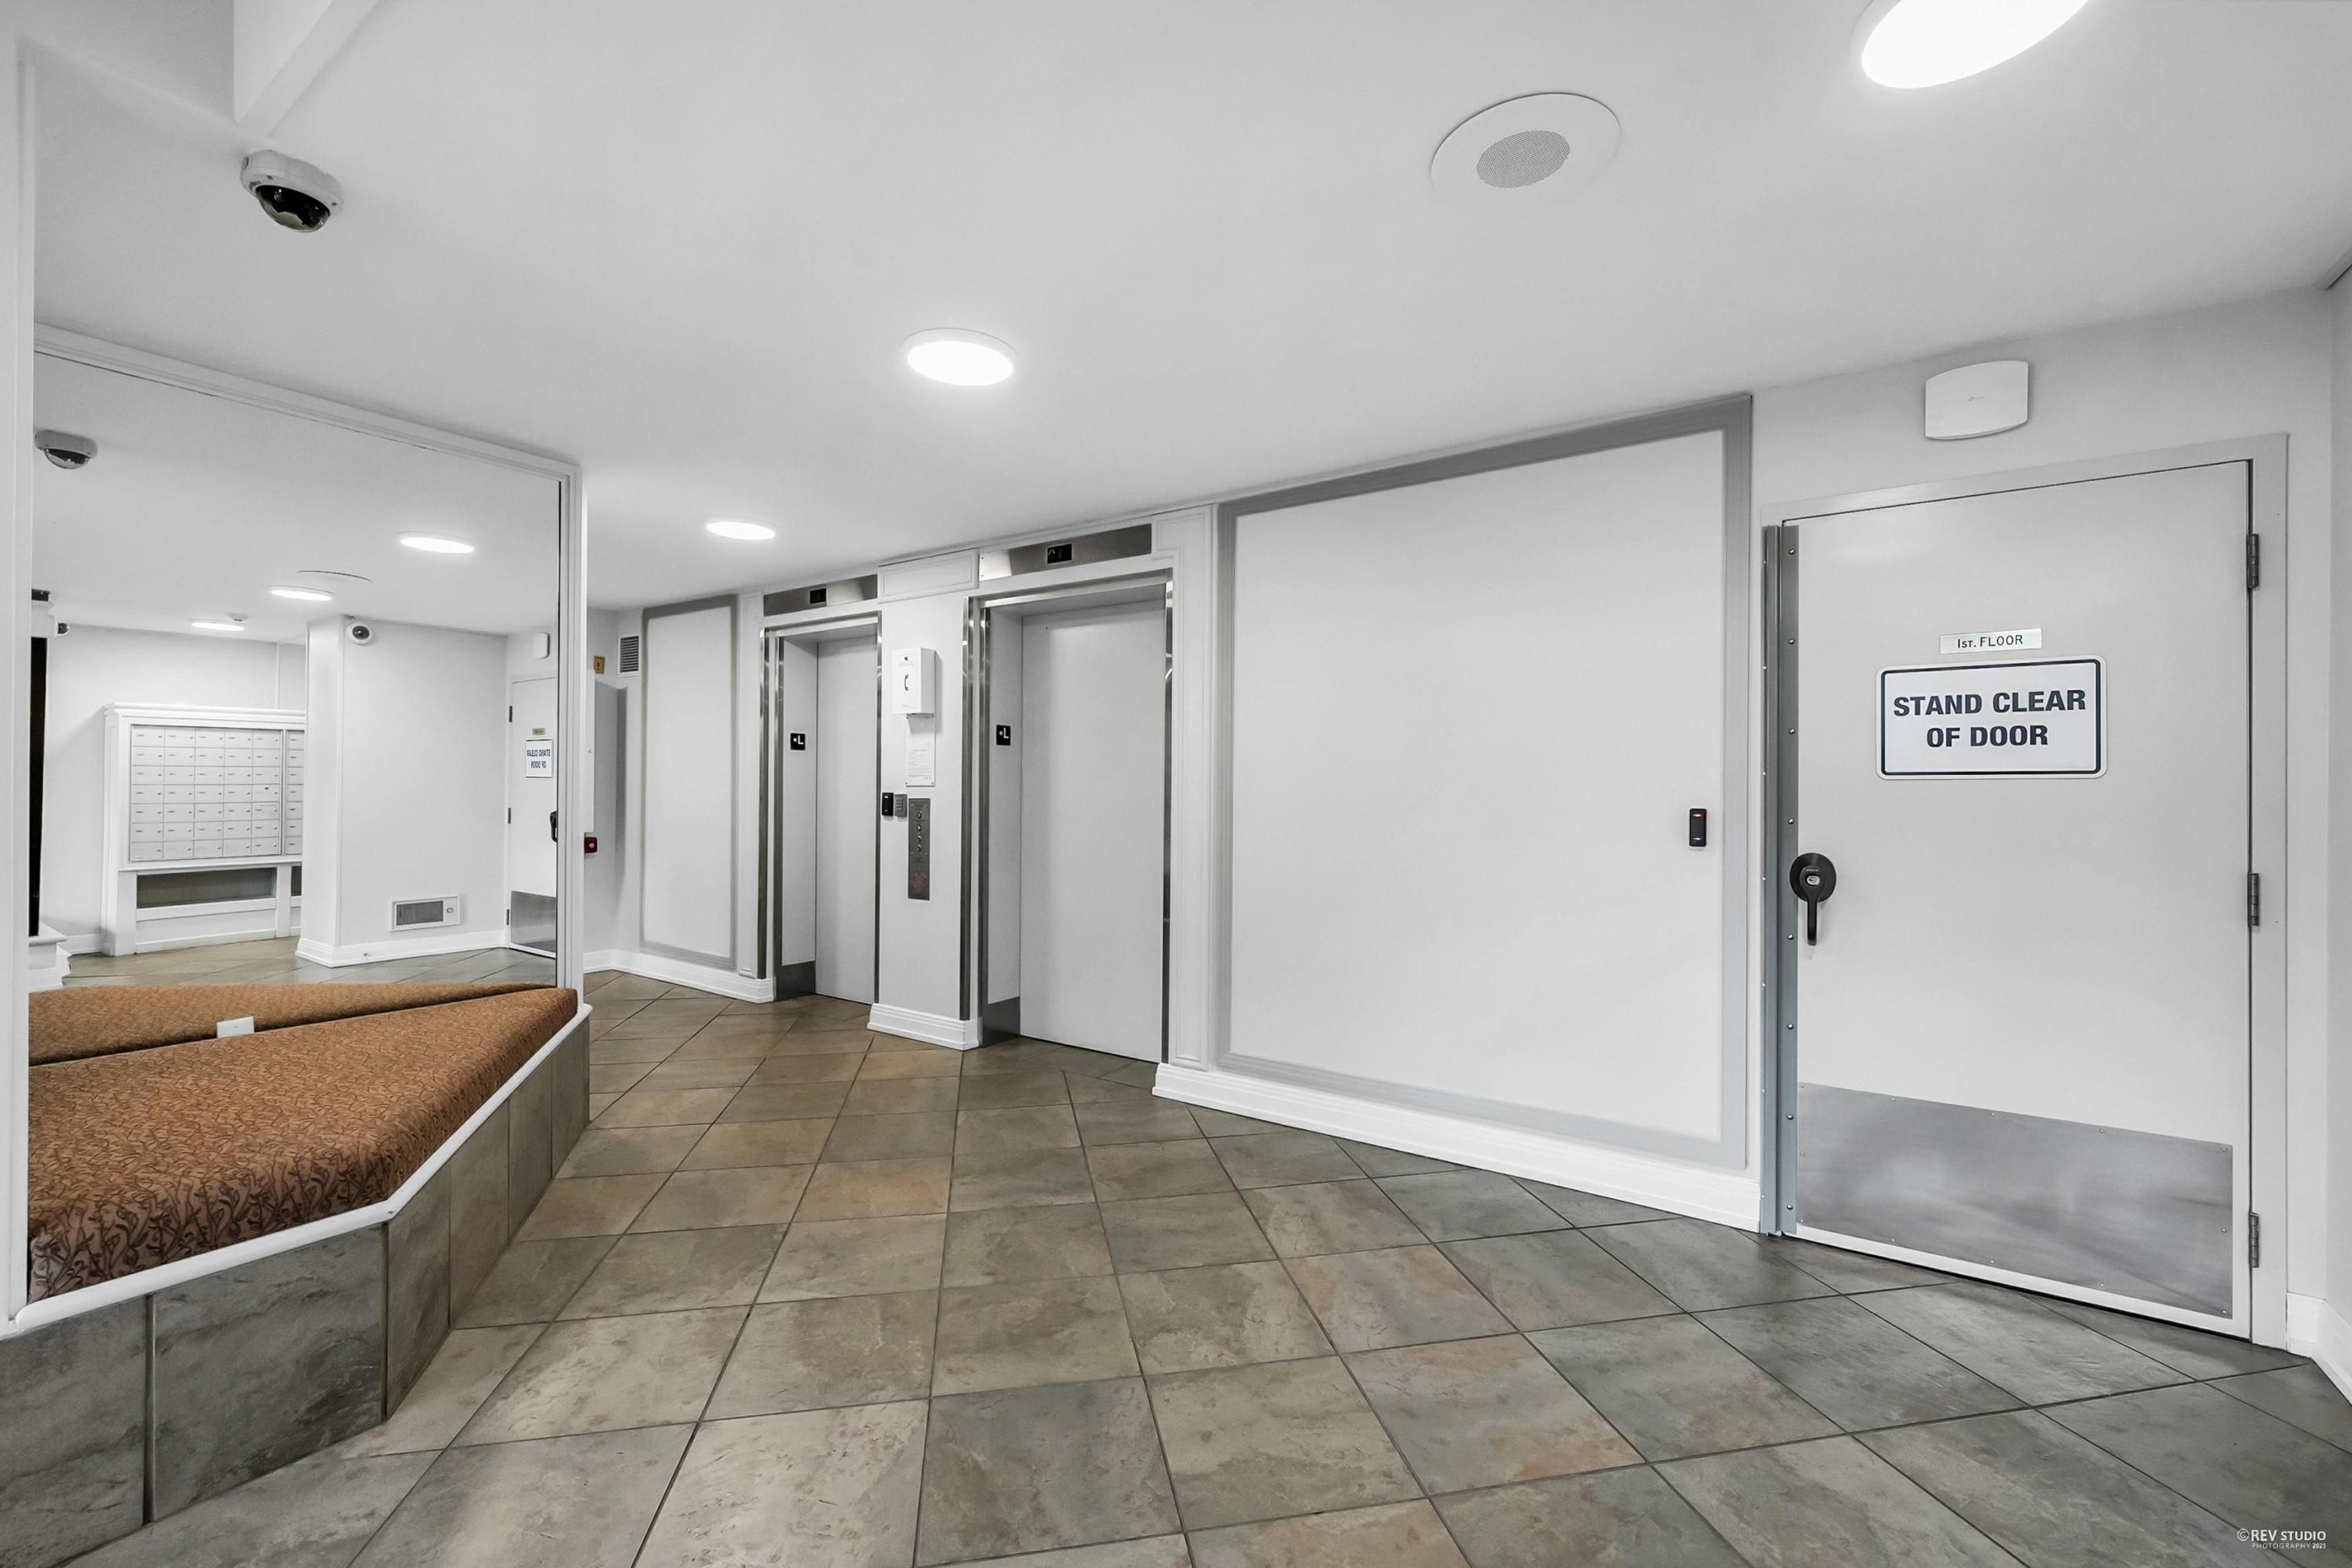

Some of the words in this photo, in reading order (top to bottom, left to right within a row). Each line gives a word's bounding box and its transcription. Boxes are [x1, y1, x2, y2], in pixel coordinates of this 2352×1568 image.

[1980, 635, 2024, 647] FLOOR
[1893, 693, 1983, 717] STAND
[1992, 689, 2086, 714] CLEAR
[1926, 727, 1961, 748] OF
[1970, 725, 2048, 747] DOOR
